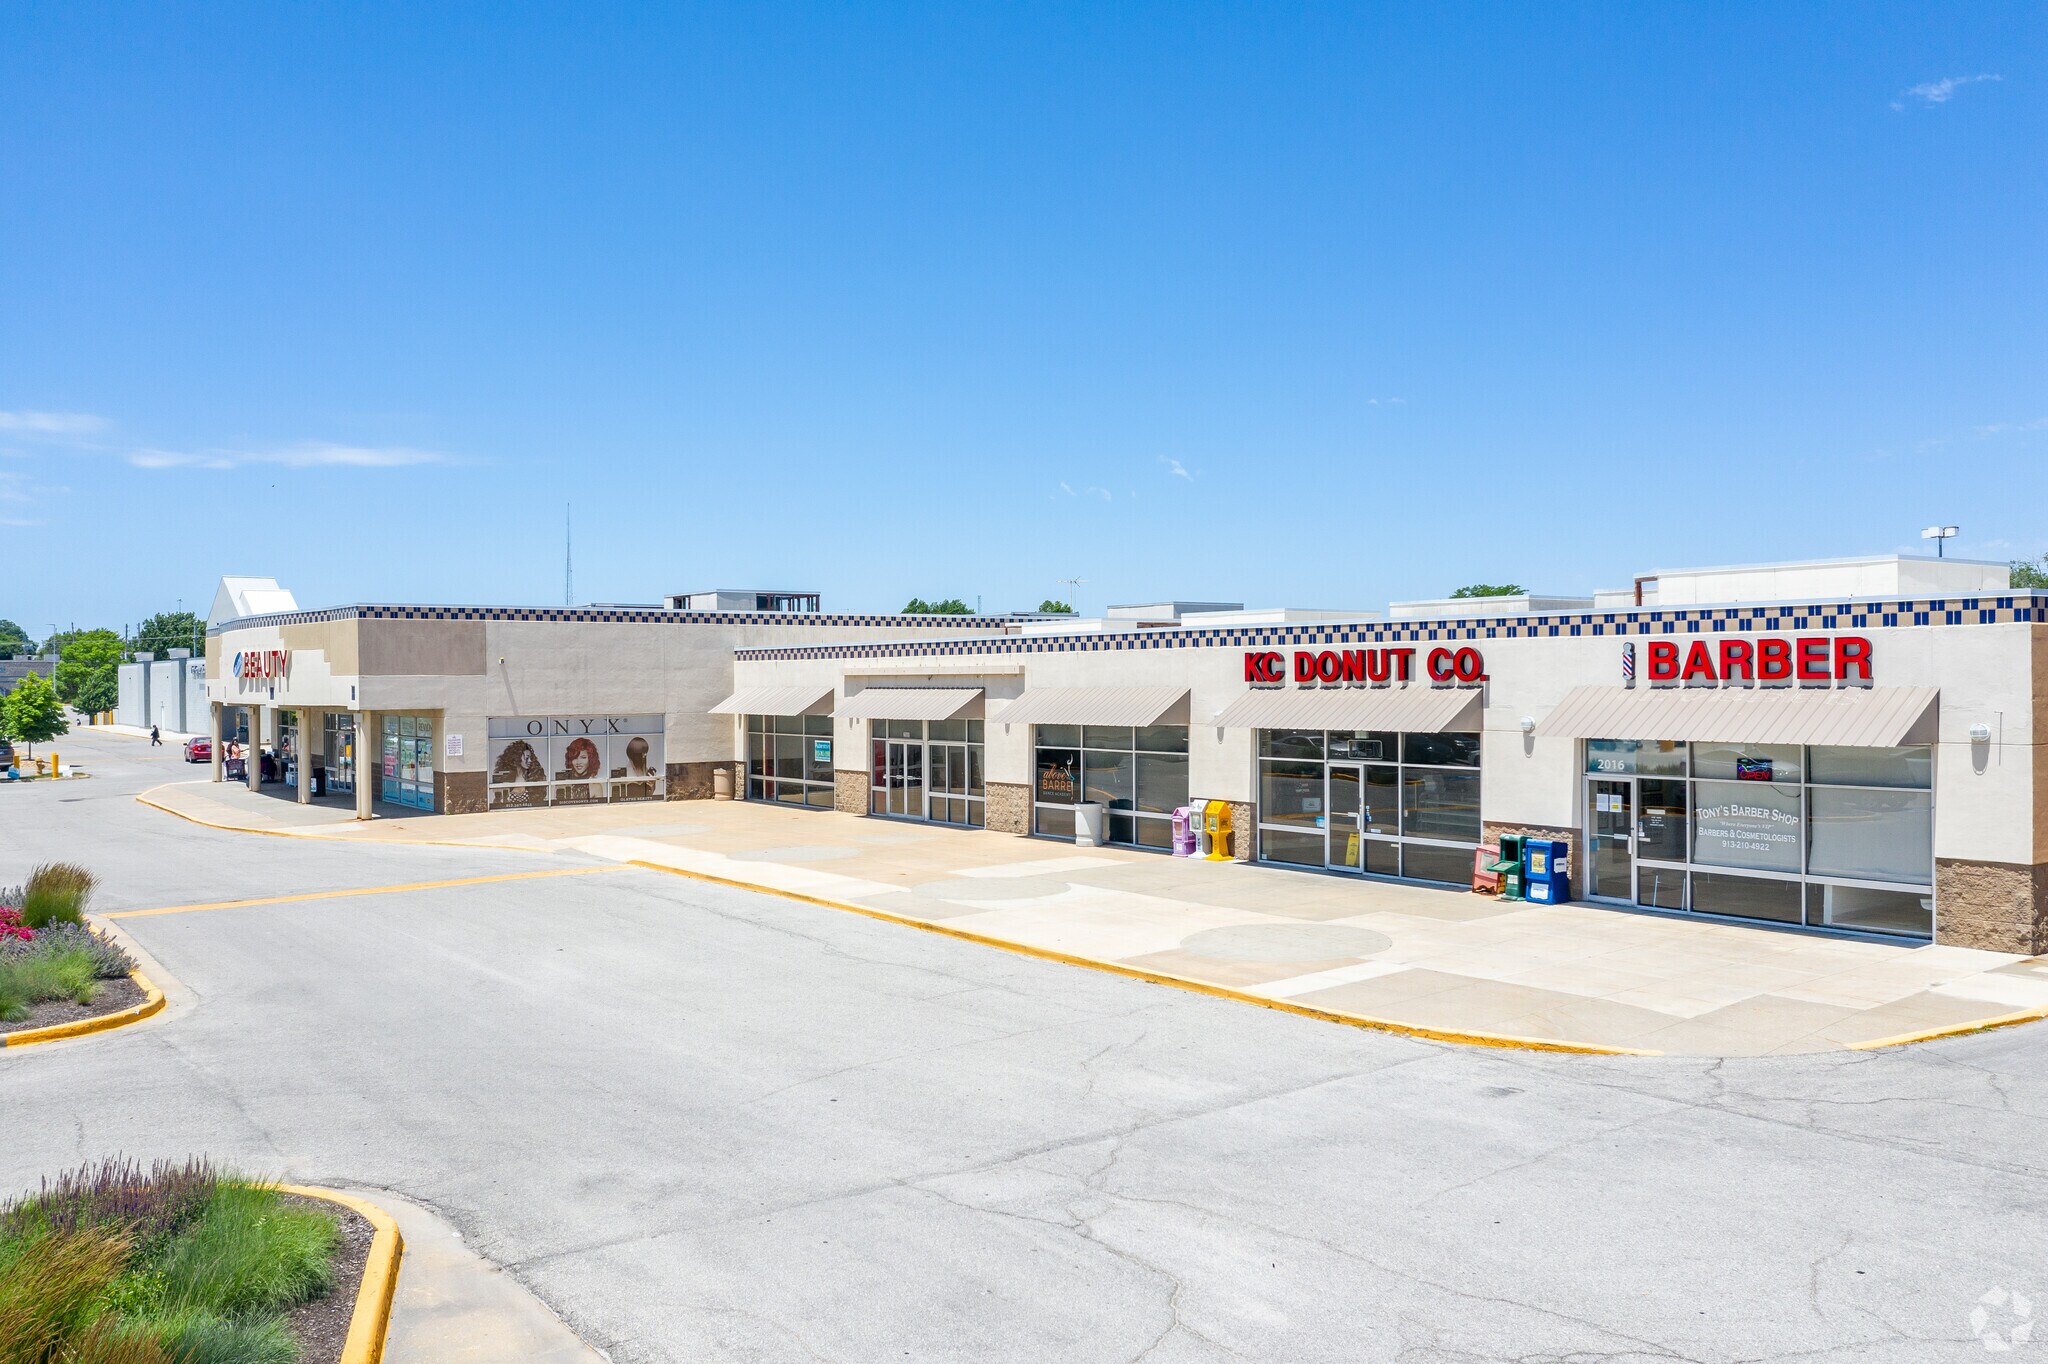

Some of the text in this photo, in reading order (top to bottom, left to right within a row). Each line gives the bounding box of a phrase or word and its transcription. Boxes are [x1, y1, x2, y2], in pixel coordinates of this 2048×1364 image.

[244, 649, 288, 678] BEAUTY
[1244, 646, 1490, 683] KC DONUT CO.
[1648, 637, 1872, 681] BARBER
[1597, 759, 1625, 770] 2016
[1740, 771, 1771, 780] OPEN
[1043, 780, 1071, 792] BARRE
[1729, 829, 1736, 838] &
[1721, 840, 1770, 851] 913-210-4922
